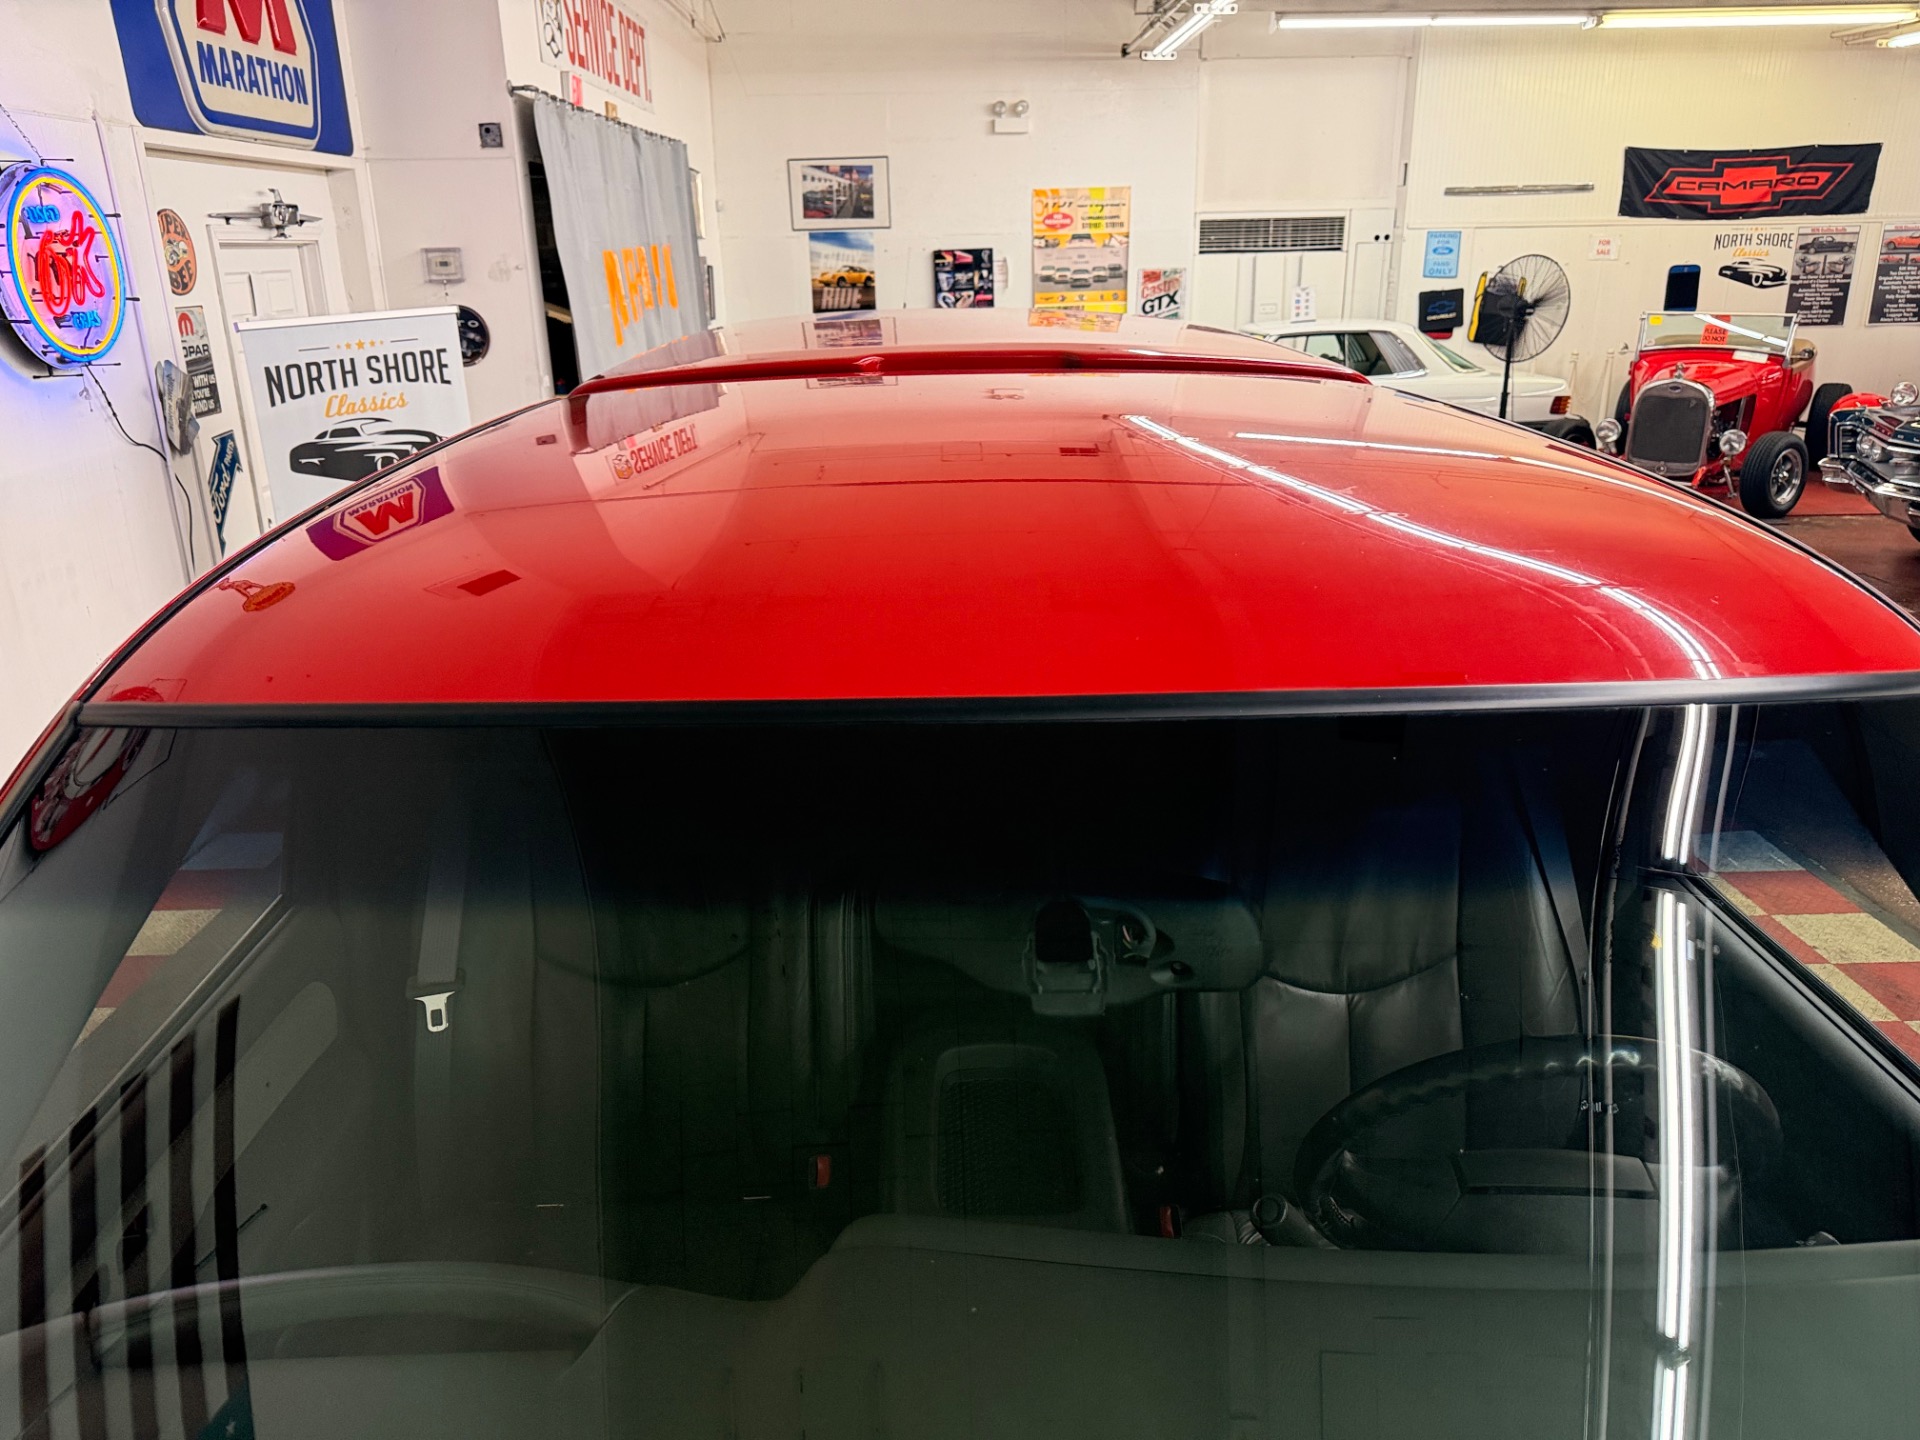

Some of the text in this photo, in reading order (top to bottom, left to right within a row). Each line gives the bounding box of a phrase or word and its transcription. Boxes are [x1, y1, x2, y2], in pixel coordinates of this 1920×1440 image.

[563, 0, 621, 88] SERVICE
[196, 40, 309, 105] MARATHON
[1676, 175, 1819, 191] CAMARO
[158, 213, 189, 241] UPER
[1714, 233, 1794, 250] NORTH SHORE
[1732, 248, 1770, 257] Classics
[168, 260, 194, 291] BEE
[1428, 267, 1453, 275] ONLY
[820, 287, 863, 310] RIDE
[1141, 289, 1179, 315] GTX
[457, 319, 480, 328] TO
[181, 343, 211, 358] OPAR
[264, 347, 452, 407] NORTH SHORE
[191, 400, 208, 414] HIND
[324, 391, 409, 418] Classics
[211, 462, 231, 525] Ford
